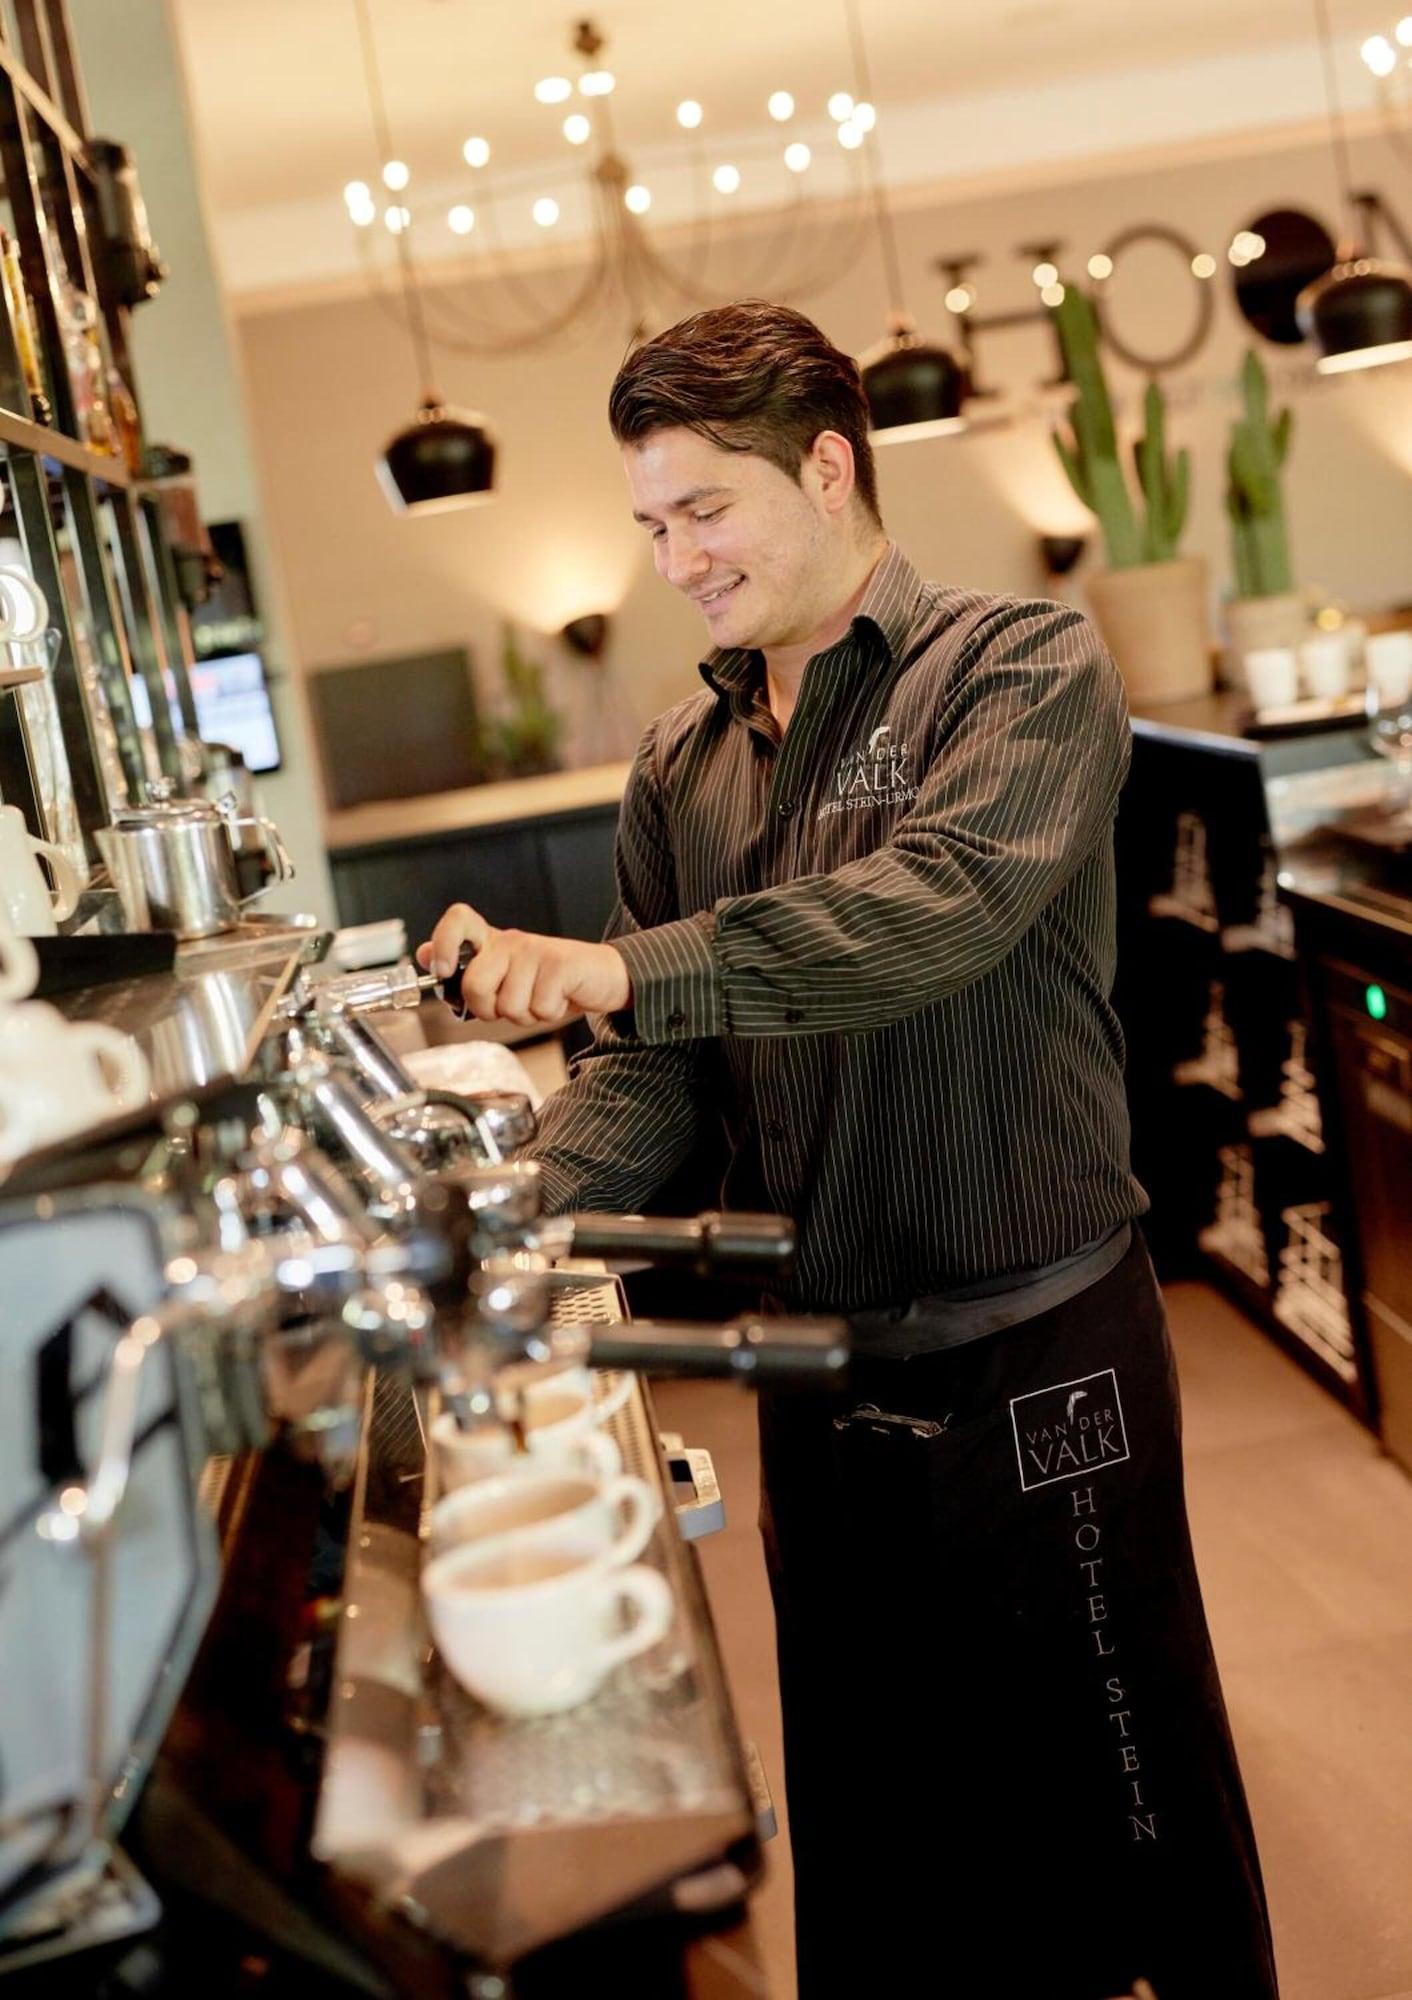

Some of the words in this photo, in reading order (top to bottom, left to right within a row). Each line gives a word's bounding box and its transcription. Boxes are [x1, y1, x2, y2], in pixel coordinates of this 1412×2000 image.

[876, 743, 908, 761] DER
[836, 757, 907, 796] VALK
[1026, 1423, 1068, 1445] VAN
[1079, 1408, 1114, 1431] DER
[1027, 1425, 1120, 1474] VALK
[1070, 1487, 1115, 1656] HOTEL
[1105, 1677, 1157, 1841] STEIN
